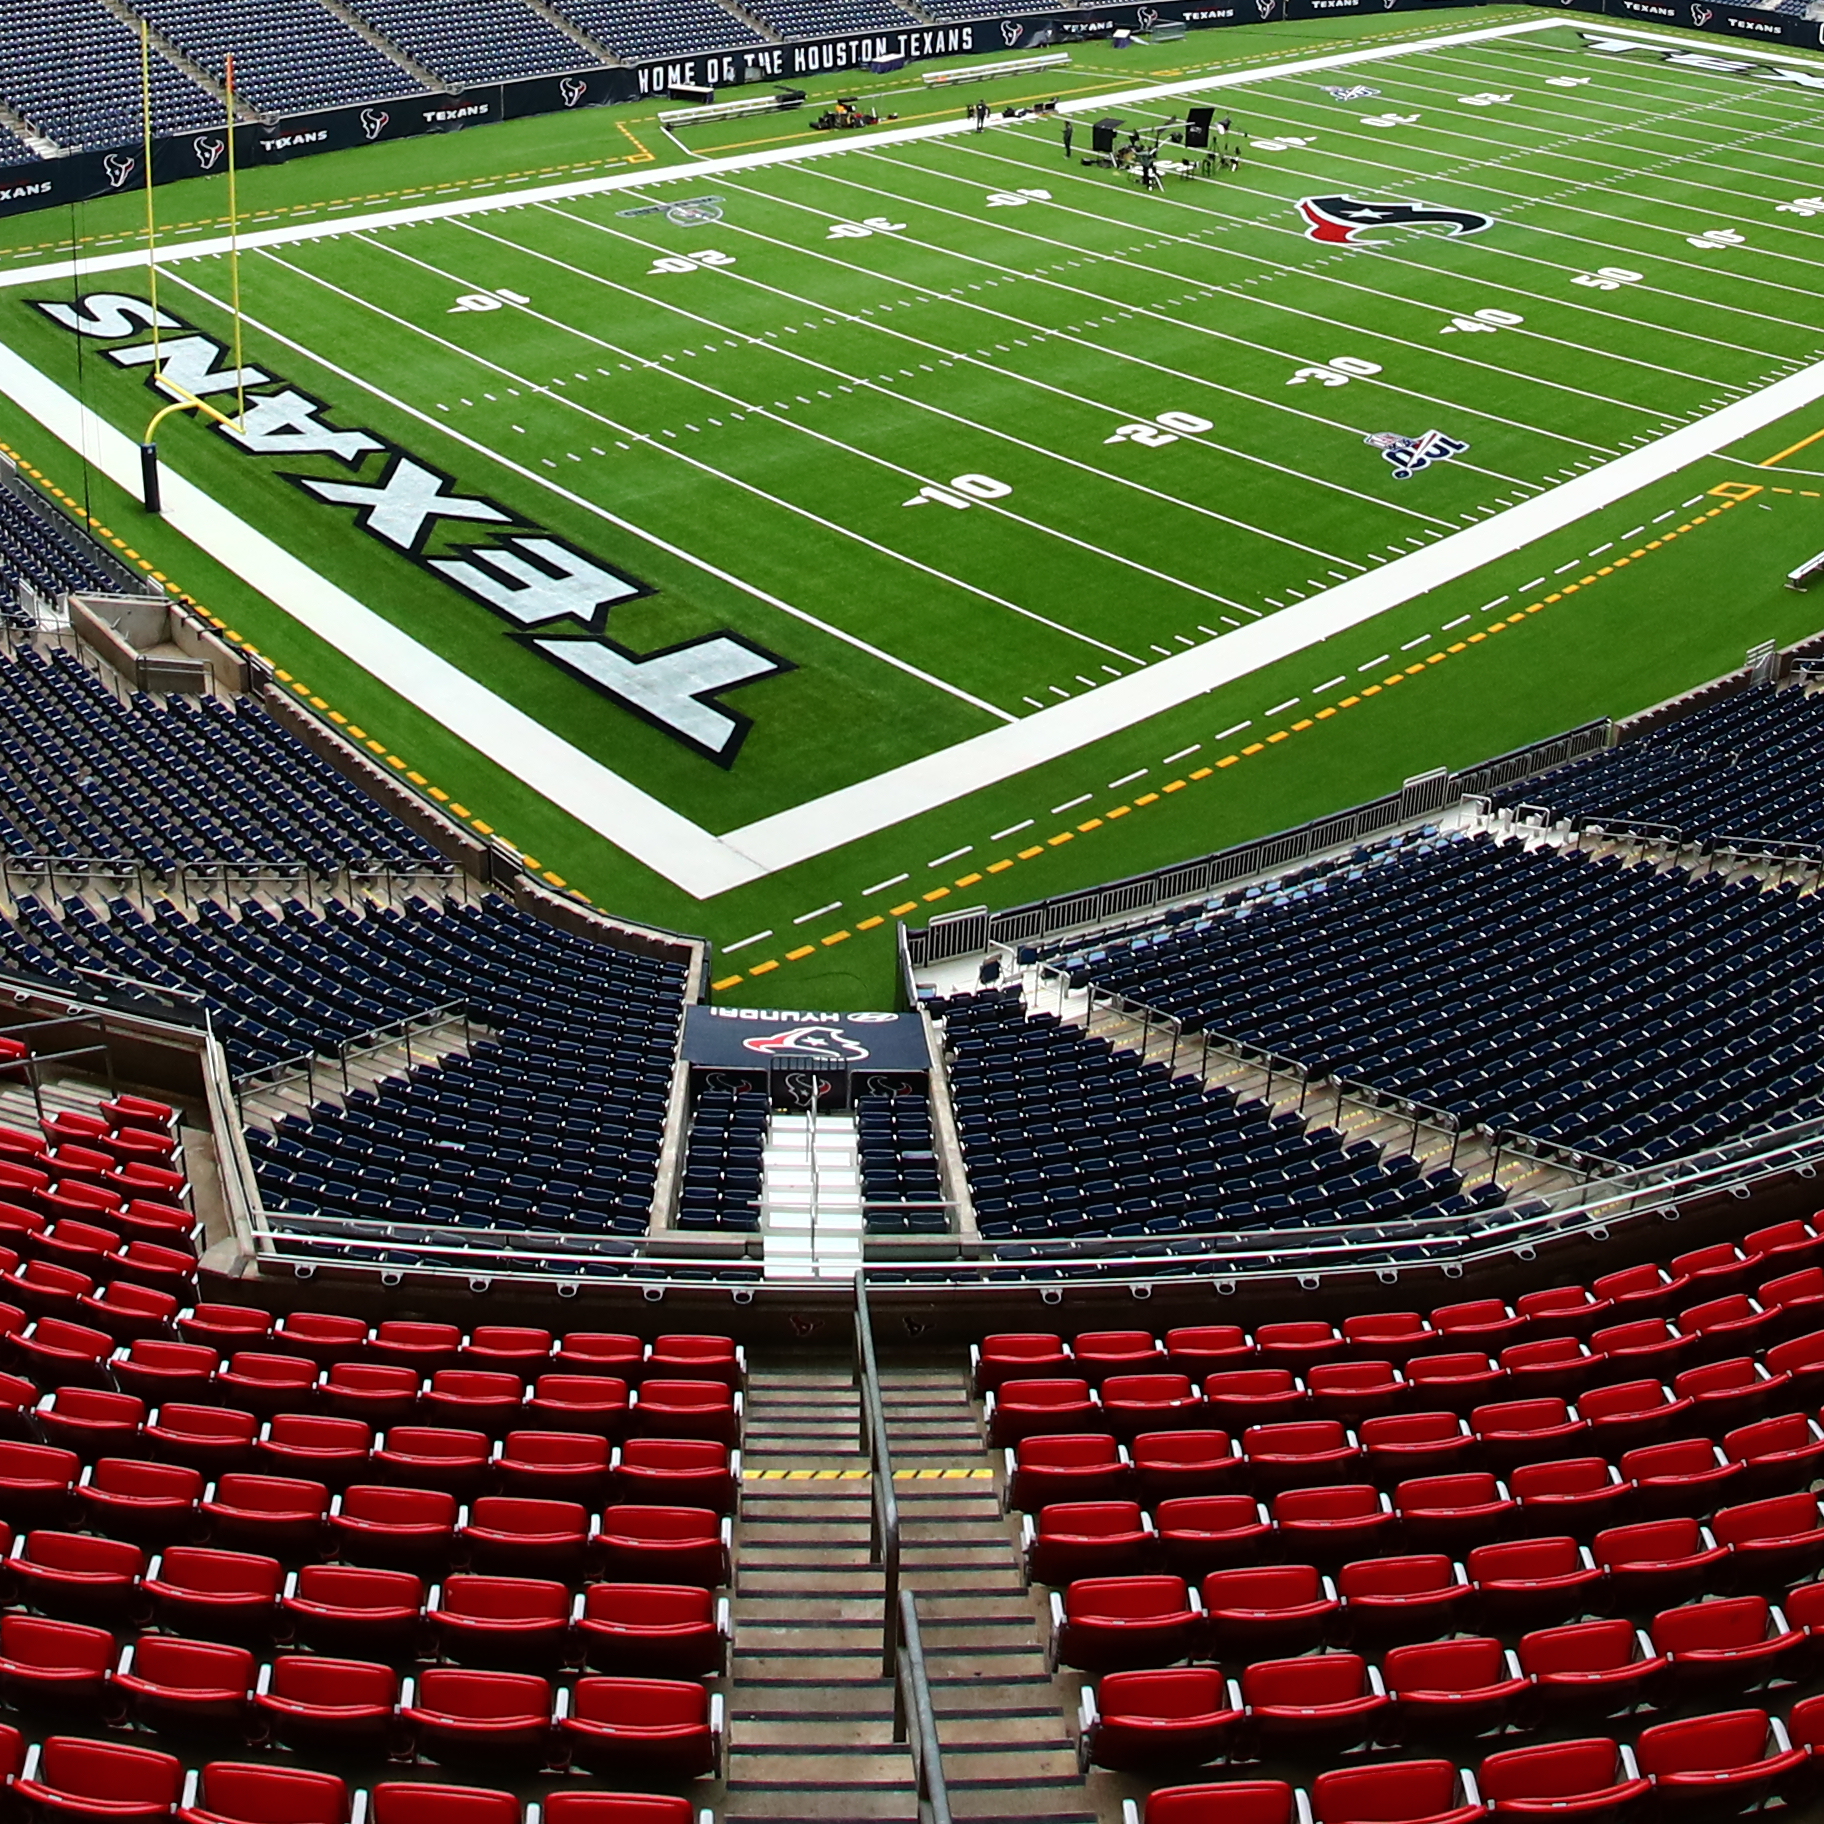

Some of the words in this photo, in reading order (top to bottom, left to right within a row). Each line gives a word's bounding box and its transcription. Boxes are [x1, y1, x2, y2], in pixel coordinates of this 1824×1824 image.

[1183, 8, 1234, 21] TEXANS
[1624, 1, 1675, 17] TEXANS
[1728, 18, 1782, 34] TEXANS
[638, 62, 695, 93] HOME
[794, 37, 886, 71] HOUSTON
[898, 27, 973, 56] TEXANS
[422, 103, 489, 122] TEXANS
[260, 129, 328, 151] TEXANS
[986, 189, 1052, 206] 40
[829, 217, 907, 237] 30
[1686, 230, 1746, 249] 40
[653, 250, 736, 273] 20
[1570, 267, 1644, 290] 50
[456, 289, 531, 311] 10
[1452, 309, 1524, 332] 40
[1295, 357, 1383, 386] 30
[1112, 411, 1217, 448] 20
[917, 474, 1015, 511] 10
[28, 292, 794, 768] TEXANS
[710, 1007, 840, 1022] HYUNDAI
